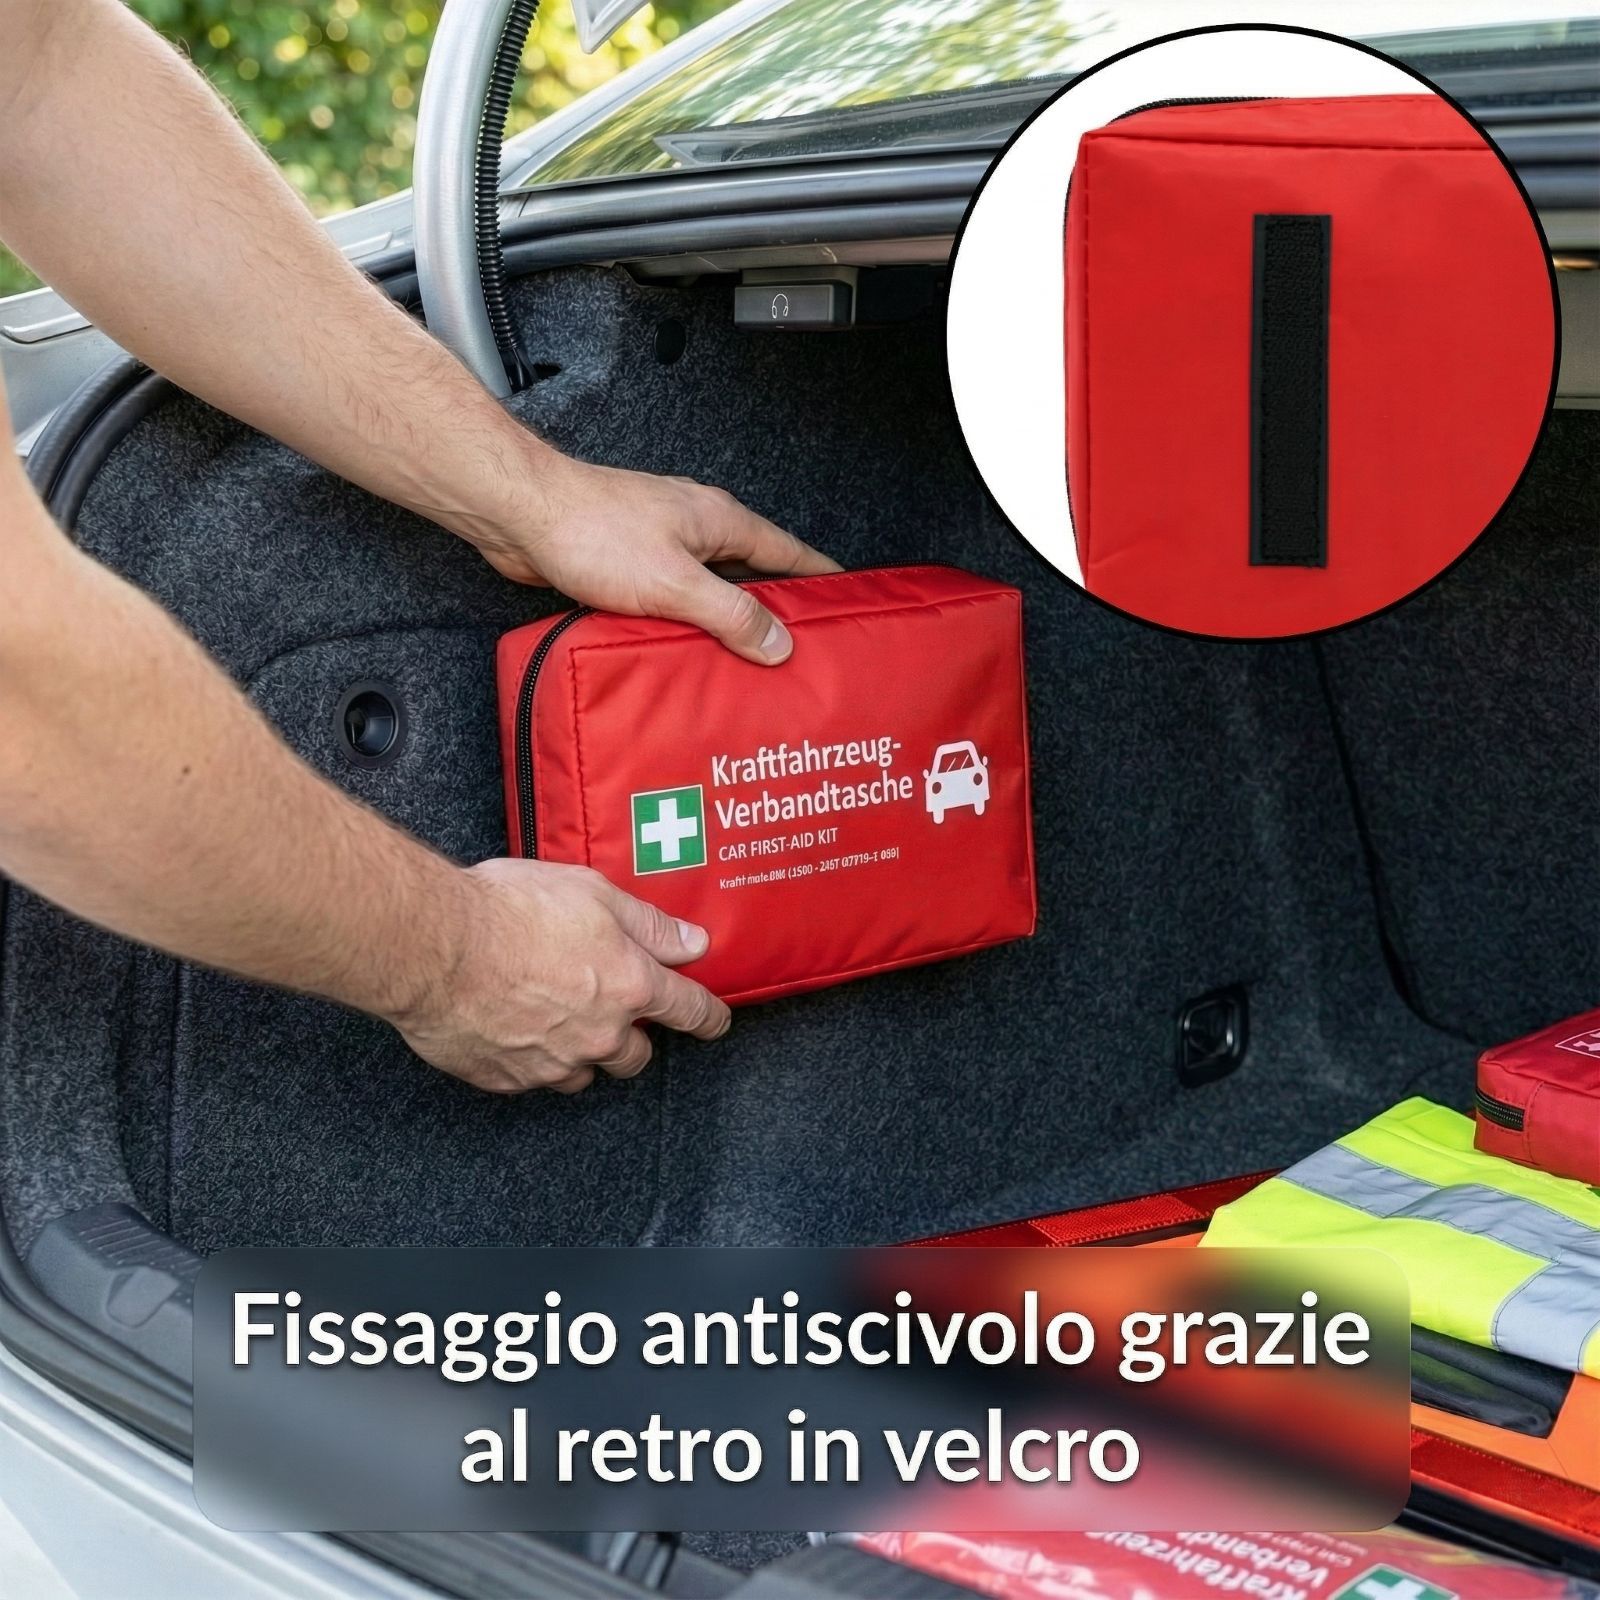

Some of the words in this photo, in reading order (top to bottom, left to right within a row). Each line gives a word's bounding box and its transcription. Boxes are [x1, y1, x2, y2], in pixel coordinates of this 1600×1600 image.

[711, 736, 901, 787] Kraftfahrzeug-
[714, 769, 913, 830] Verbandtasche
[718, 842, 747, 861] CAR
[750, 832, 814, 857] FIRST-AID
[818, 827, 838, 844] KIT
